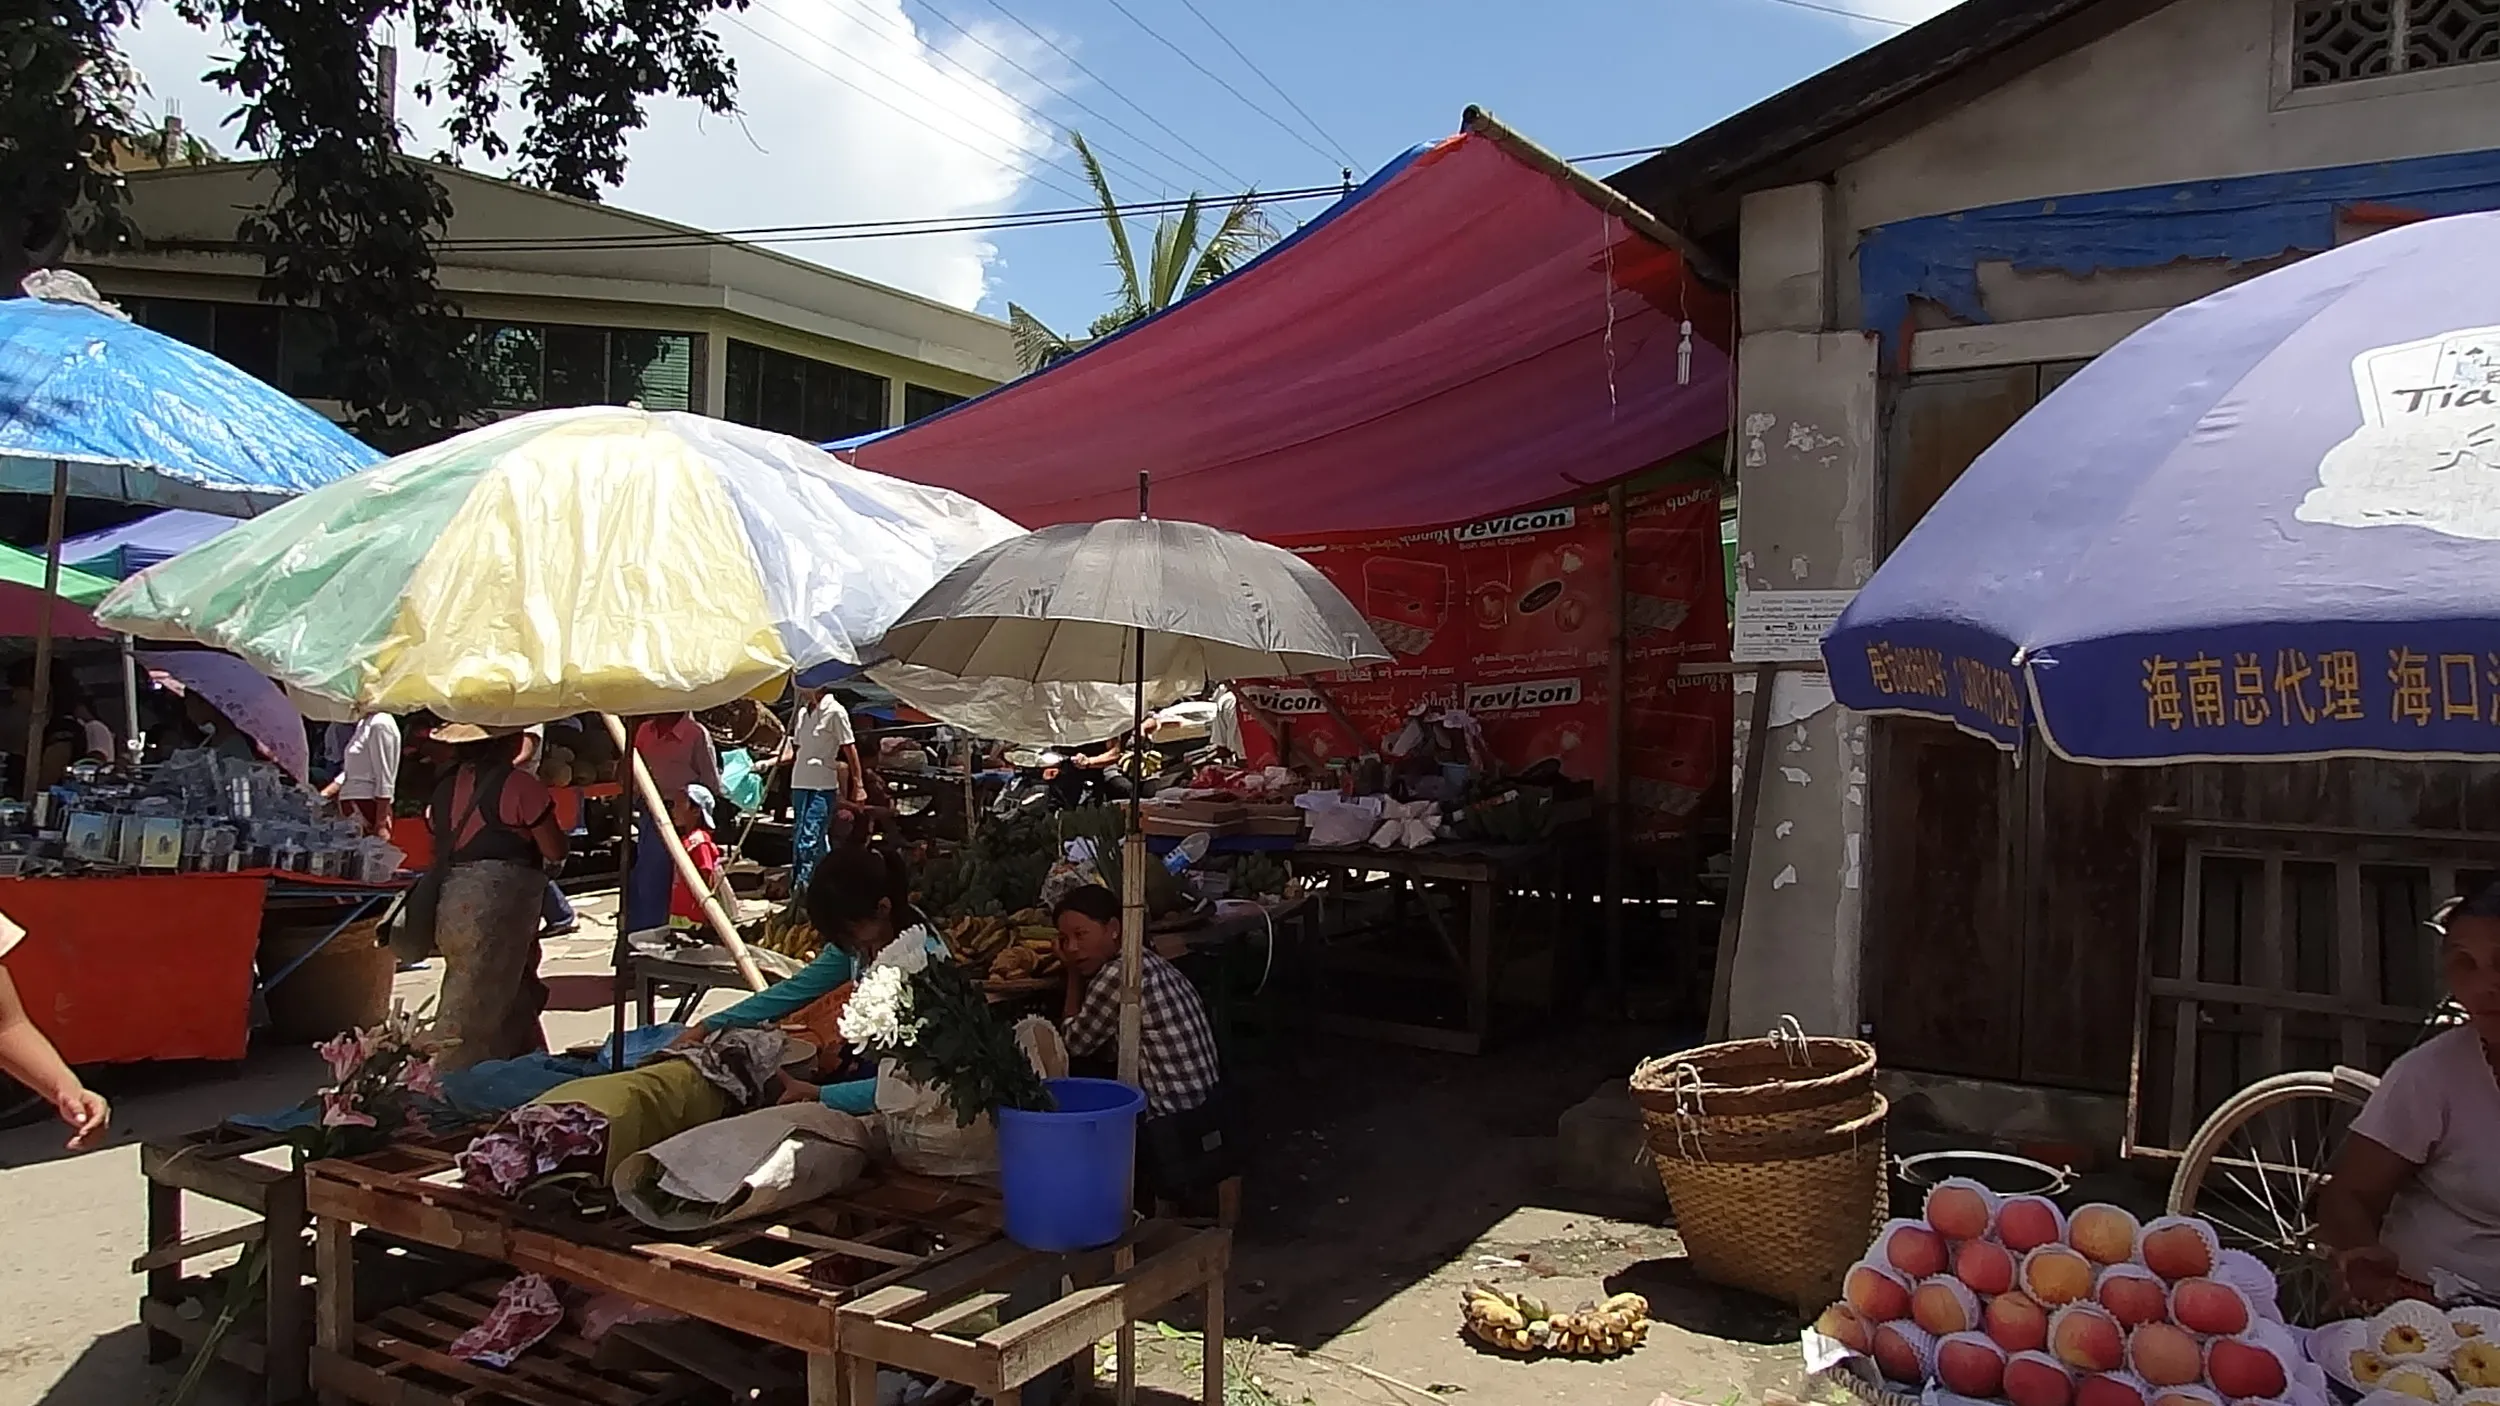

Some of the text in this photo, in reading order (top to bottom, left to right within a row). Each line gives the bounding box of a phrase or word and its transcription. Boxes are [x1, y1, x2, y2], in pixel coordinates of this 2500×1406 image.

[1460, 511, 1567, 539] revicon
[1468, 684, 1573, 708] revicon
[2141, 644, 2500, 731] 海南总代理 海口
[1249, 692, 1321, 710] vicon
